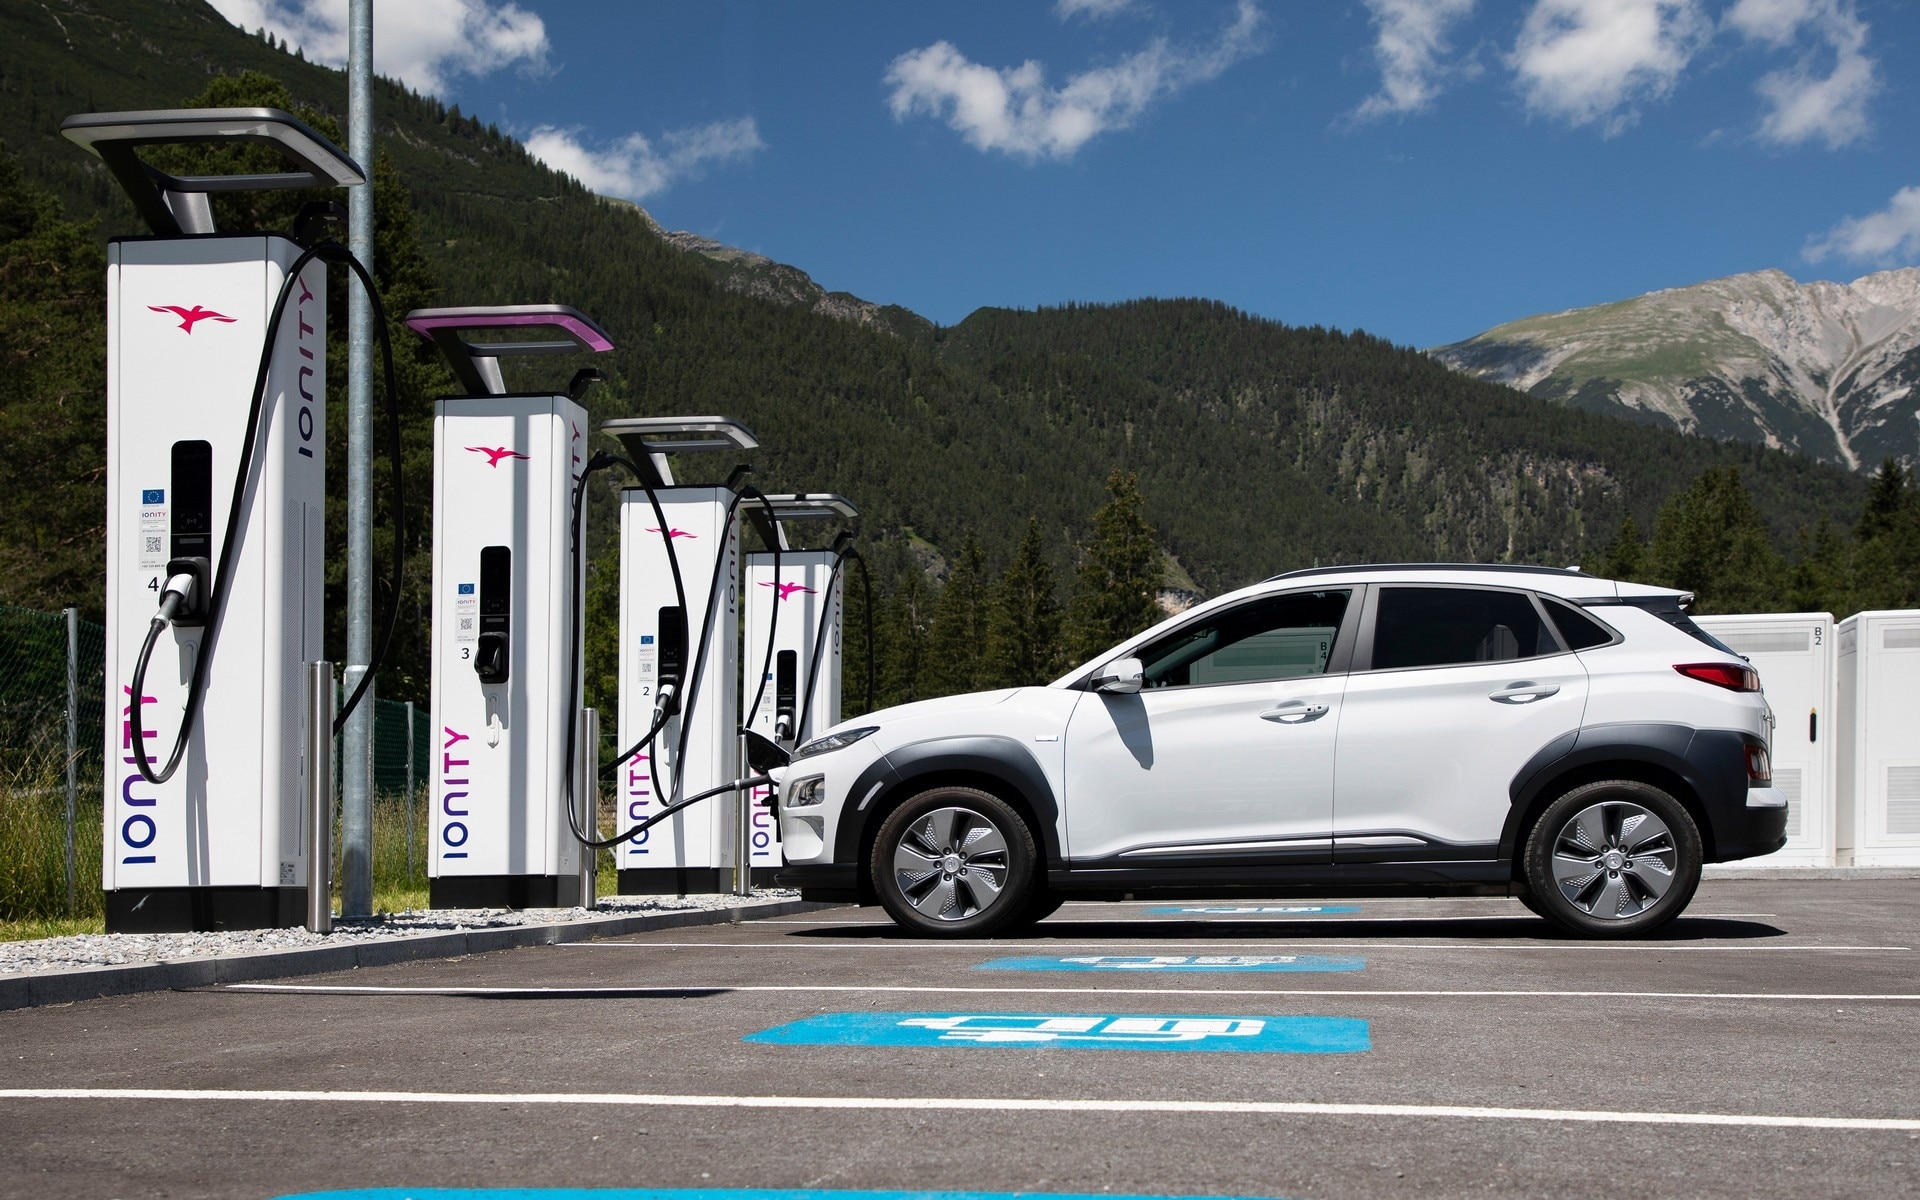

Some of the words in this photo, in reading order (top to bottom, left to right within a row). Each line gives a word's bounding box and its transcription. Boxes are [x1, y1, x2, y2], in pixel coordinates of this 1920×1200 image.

[298, 275, 314, 459] IONITY
[147, 576, 159, 592] 4
[461, 647, 470, 660] 3
[642, 686, 650, 696] 2
[764, 715, 769, 724] 1
[443, 726, 469, 859] IONITY
